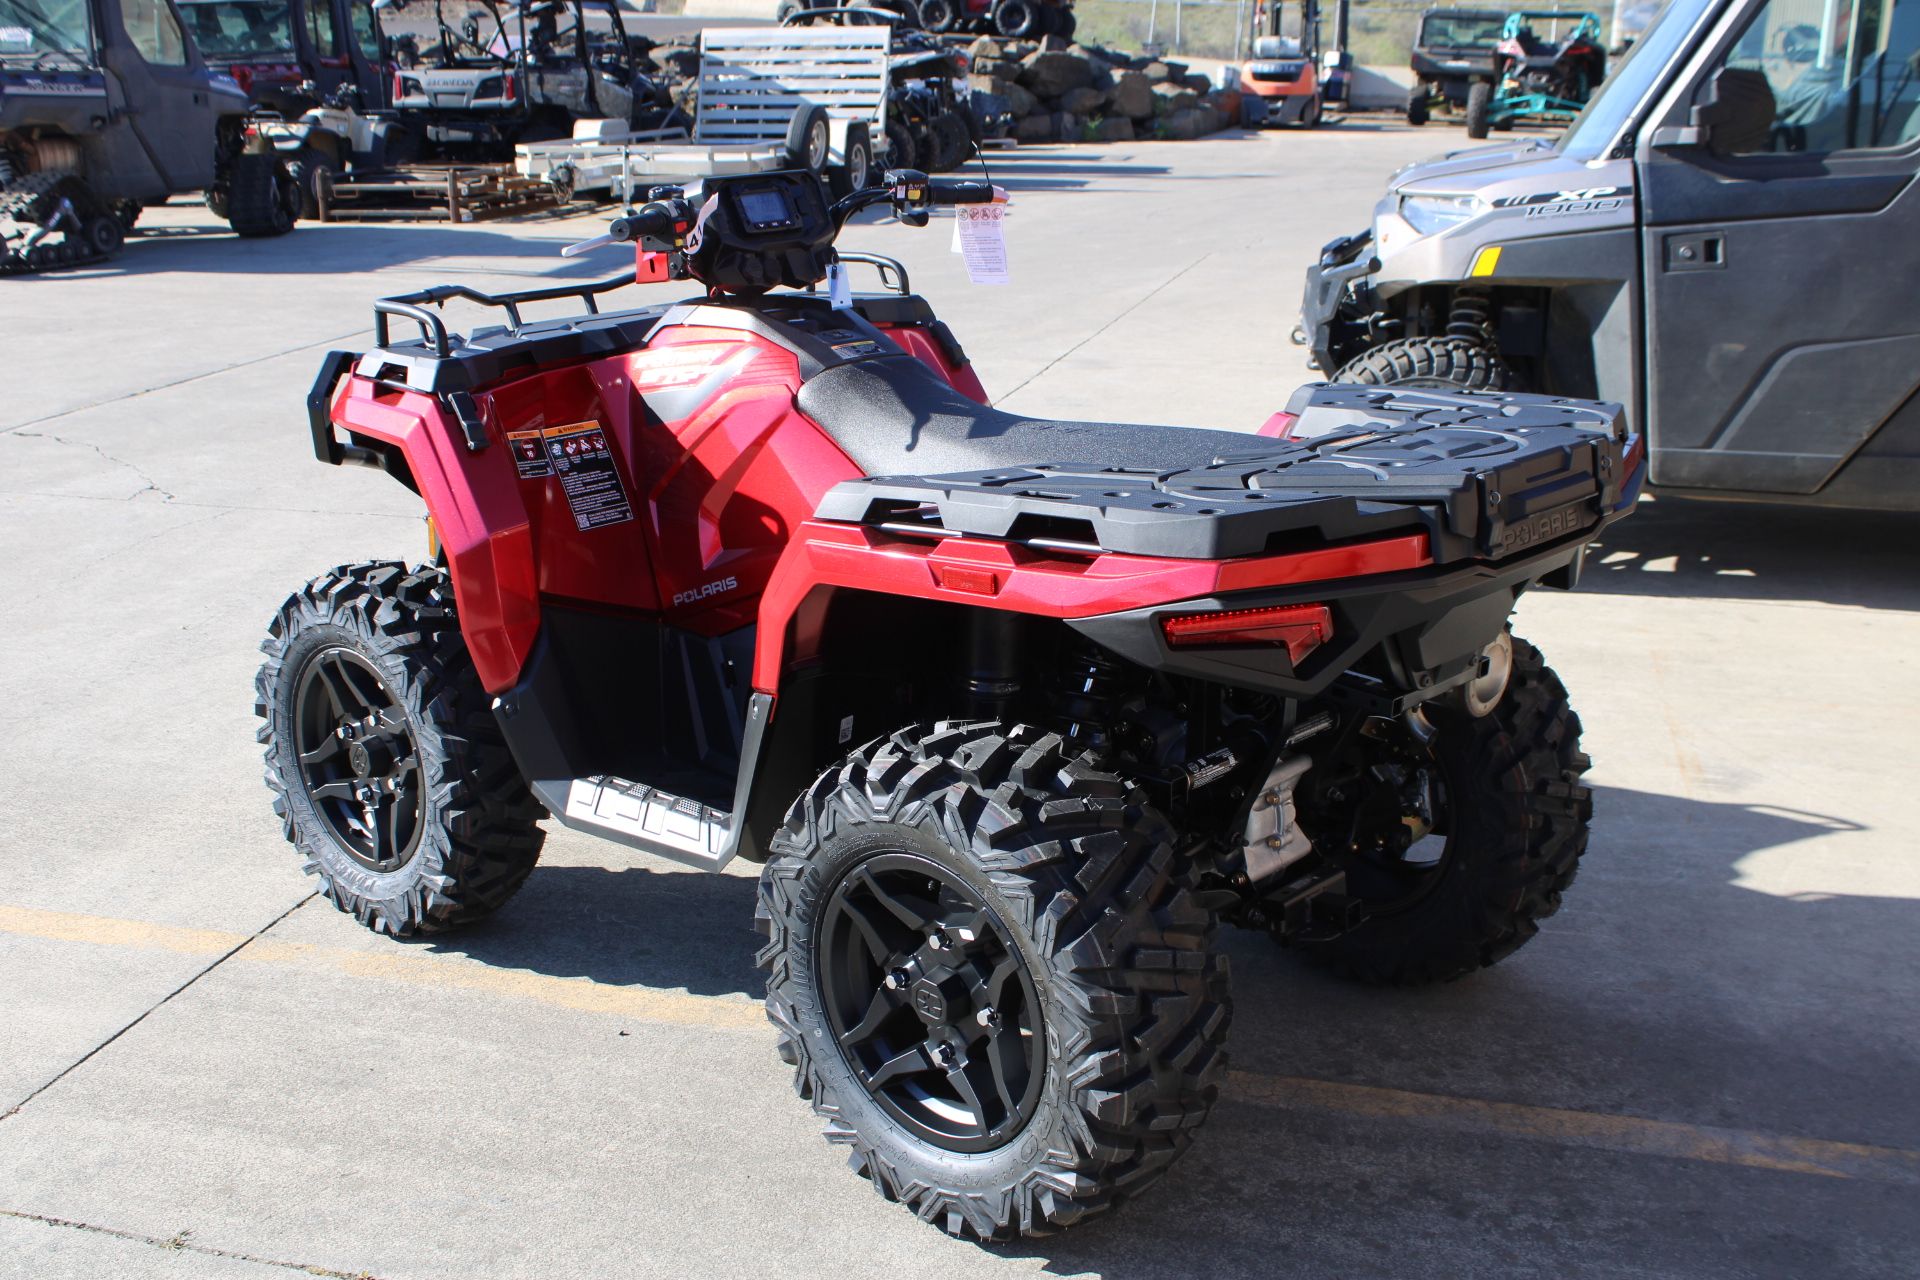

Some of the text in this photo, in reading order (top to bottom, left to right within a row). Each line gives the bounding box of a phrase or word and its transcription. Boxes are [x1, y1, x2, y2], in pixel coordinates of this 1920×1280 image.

[1549, 187, 1617, 203] XP
[1525, 199, 1623, 218] 1000
[1503, 508, 1578, 550] POLARIS
[673, 576, 737, 606] POLARIS
